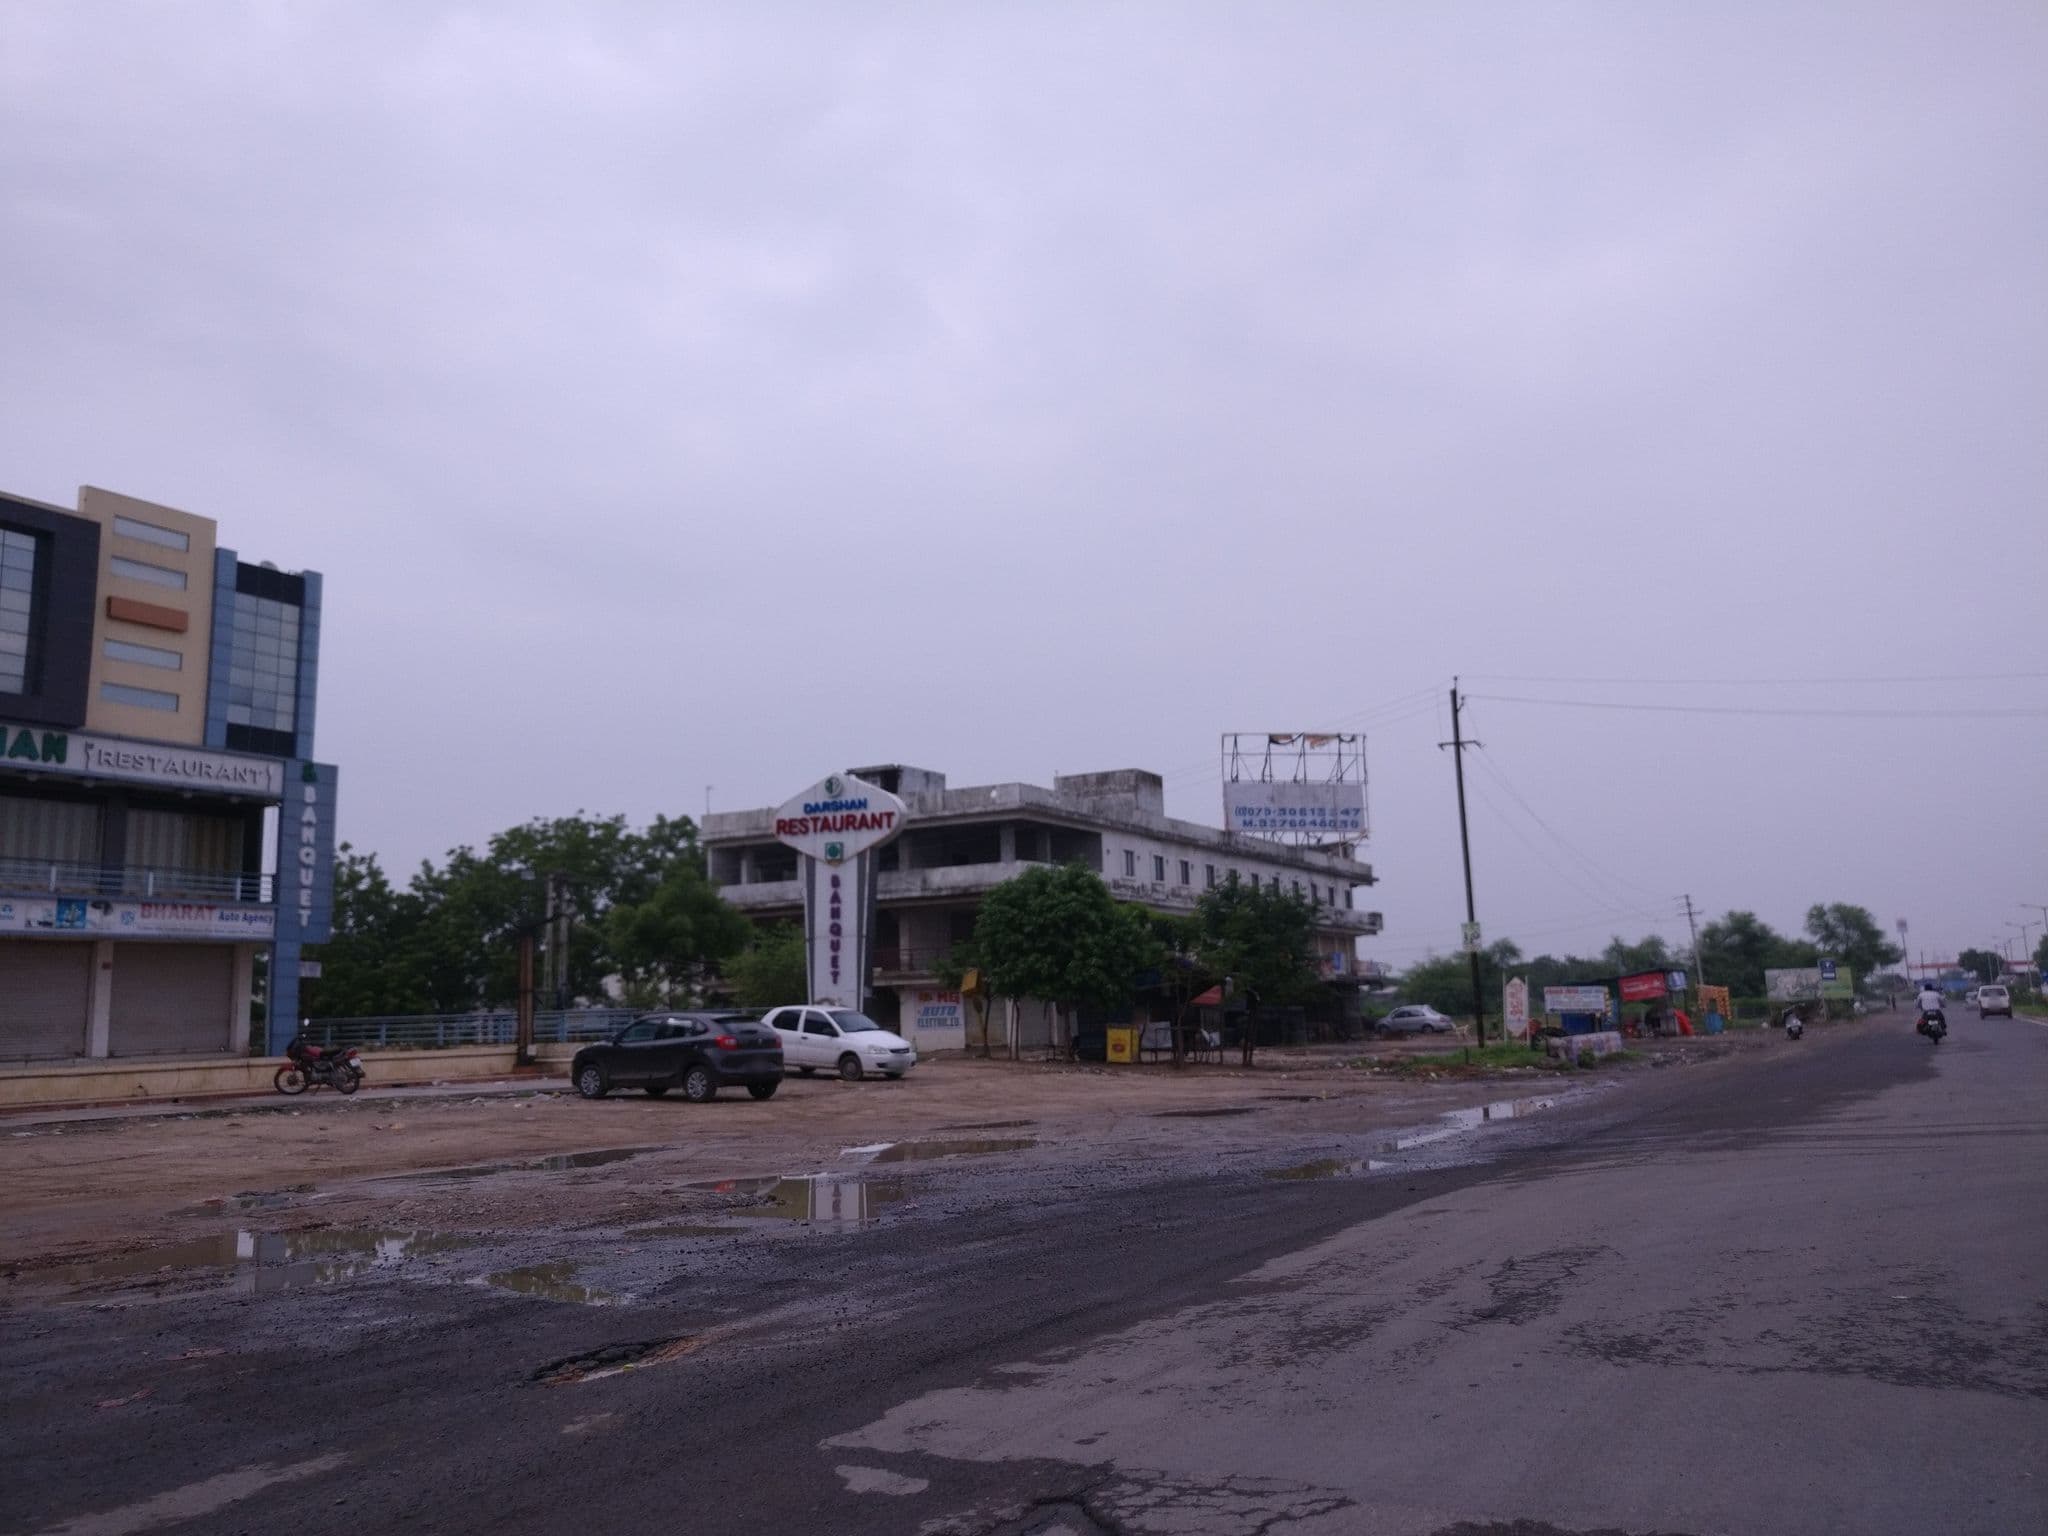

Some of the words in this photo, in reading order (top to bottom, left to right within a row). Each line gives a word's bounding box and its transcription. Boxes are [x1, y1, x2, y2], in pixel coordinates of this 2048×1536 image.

[98, 748, 264, 785] RESTAURANT
[776, 811, 895, 837] RESTAURANT
[803, 798, 868, 814] DARSHAN
[298, 785, 317, 928] BANQUET
[829, 874, 842, 985] BANQUET
